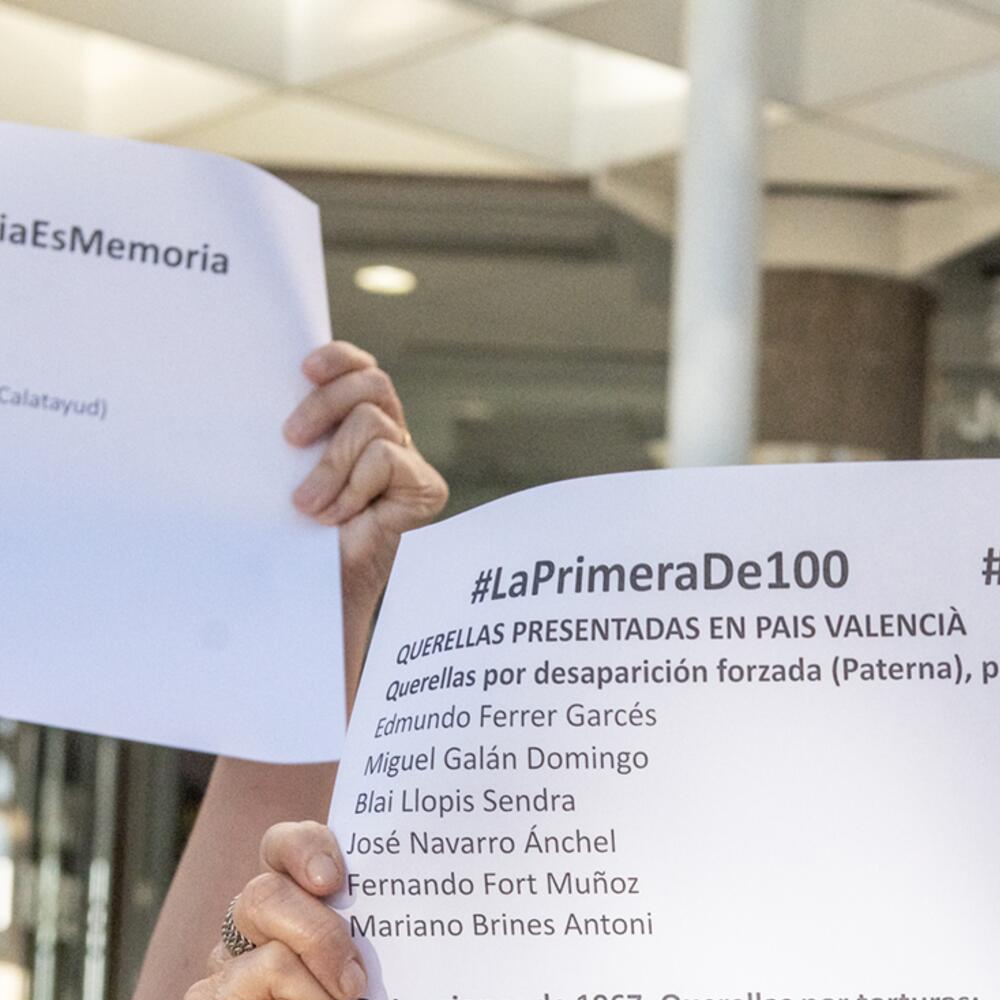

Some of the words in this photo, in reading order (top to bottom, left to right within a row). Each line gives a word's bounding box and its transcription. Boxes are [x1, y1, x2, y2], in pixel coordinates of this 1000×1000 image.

[0, 213, 230, 276] iaEsMemoria
[470, 549, 850, 605] #LaPrimeraDe100
[396, 622, 505, 666] QUERELLAS
[511, 616, 701, 644] PRESENTADAS
[709, 615, 746, 640] EN
[756, 614, 817, 640] PAIS
[824, 605, 968, 639] VALENCIÀ
[385, 665, 477, 702] Querellas
[482, 667, 527, 692] por
[533, 657, 708, 691] desaparición
[716, 656, 822, 683] forzada
[831, 653, 972, 688] (Paterna),
[374, 704, 471, 739] Edmundo
[479, 704, 558, 728] Ferrer
[566, 701, 657, 728] Garcés
[363, 746, 436, 778] Miguel
[443, 744, 517, 771] Galán
[527, 745, 649, 776] Domingo
[354, 789, 394, 815] Blai
[401, 787, 475, 819] Llopis
[483, 787, 576, 813] Sendra
[346, 829, 401, 855] José
[409, 831, 516, 855] Navarro
[524, 824, 616, 854] Ánchel
[347, 871, 475, 897] Fernando
[483, 872, 538, 896] Fort
[546, 870, 640, 895] Muñoz
[350, 913, 464, 938] Mariano
[472, 912, 556, 936] Brines
[563, 911, 653, 936] Antoni
